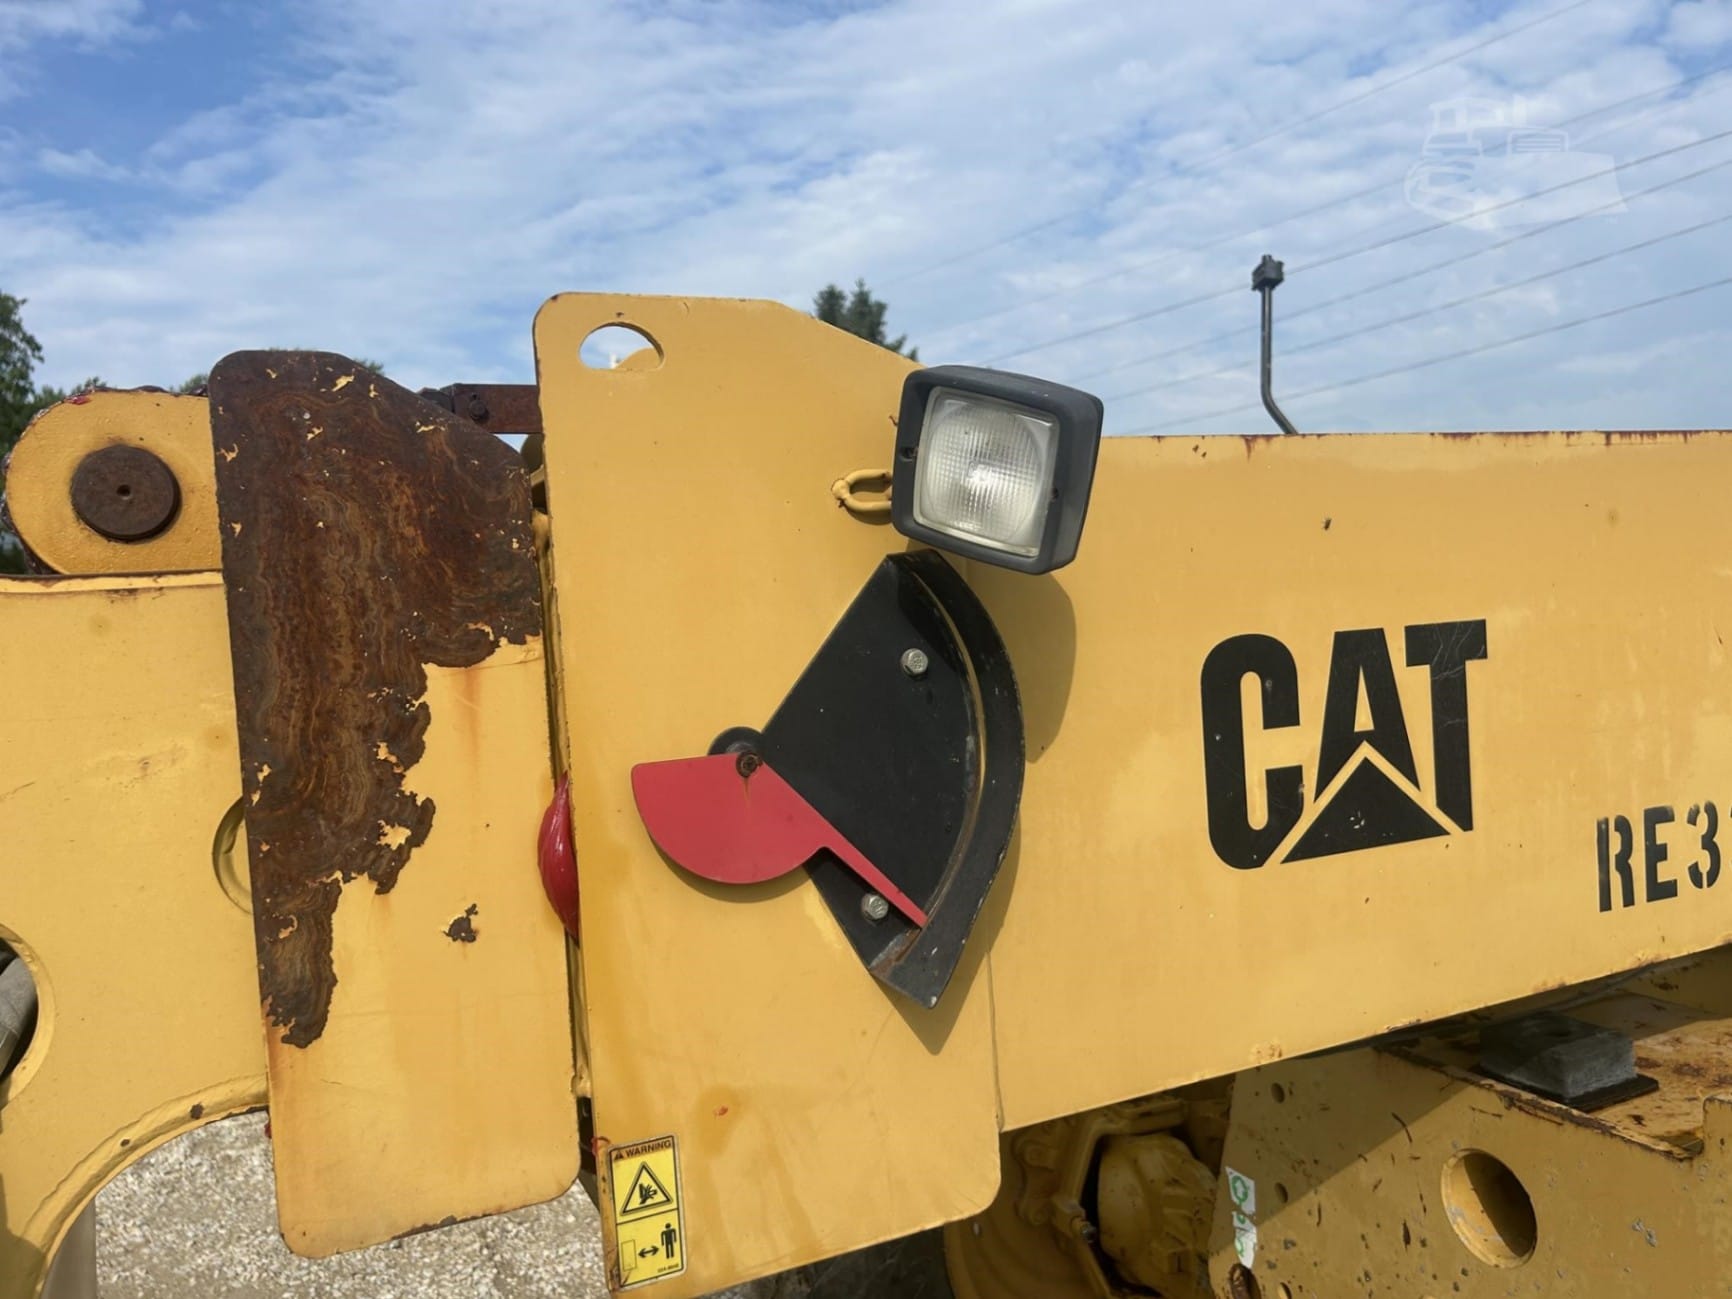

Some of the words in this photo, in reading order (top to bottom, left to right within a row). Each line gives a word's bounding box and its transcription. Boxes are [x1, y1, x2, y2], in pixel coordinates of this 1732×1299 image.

[1201, 619, 1488, 870] CAT
[1596, 800, 1732, 912] RE3
[625, 1140, 672, 1158] WARNING
